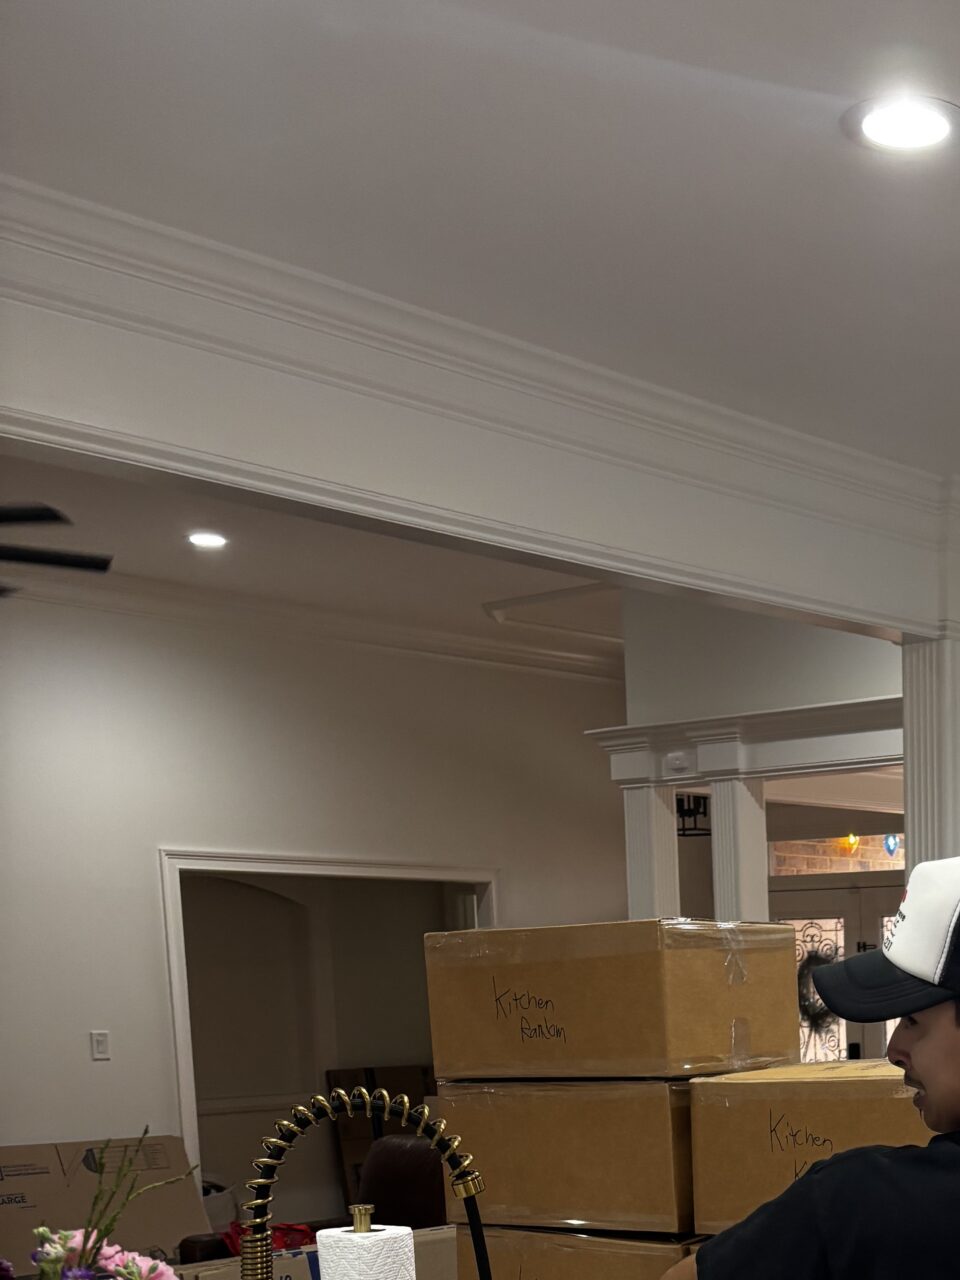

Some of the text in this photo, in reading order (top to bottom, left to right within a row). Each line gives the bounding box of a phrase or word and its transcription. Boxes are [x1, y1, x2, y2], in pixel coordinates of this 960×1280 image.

[492, 975, 555, 1020] Kitchen
[520, 1016, 567, 1044] Random
[769, 1107, 834, 1153] Kitchen
[0, 1196, 27, 1206] ARGE
